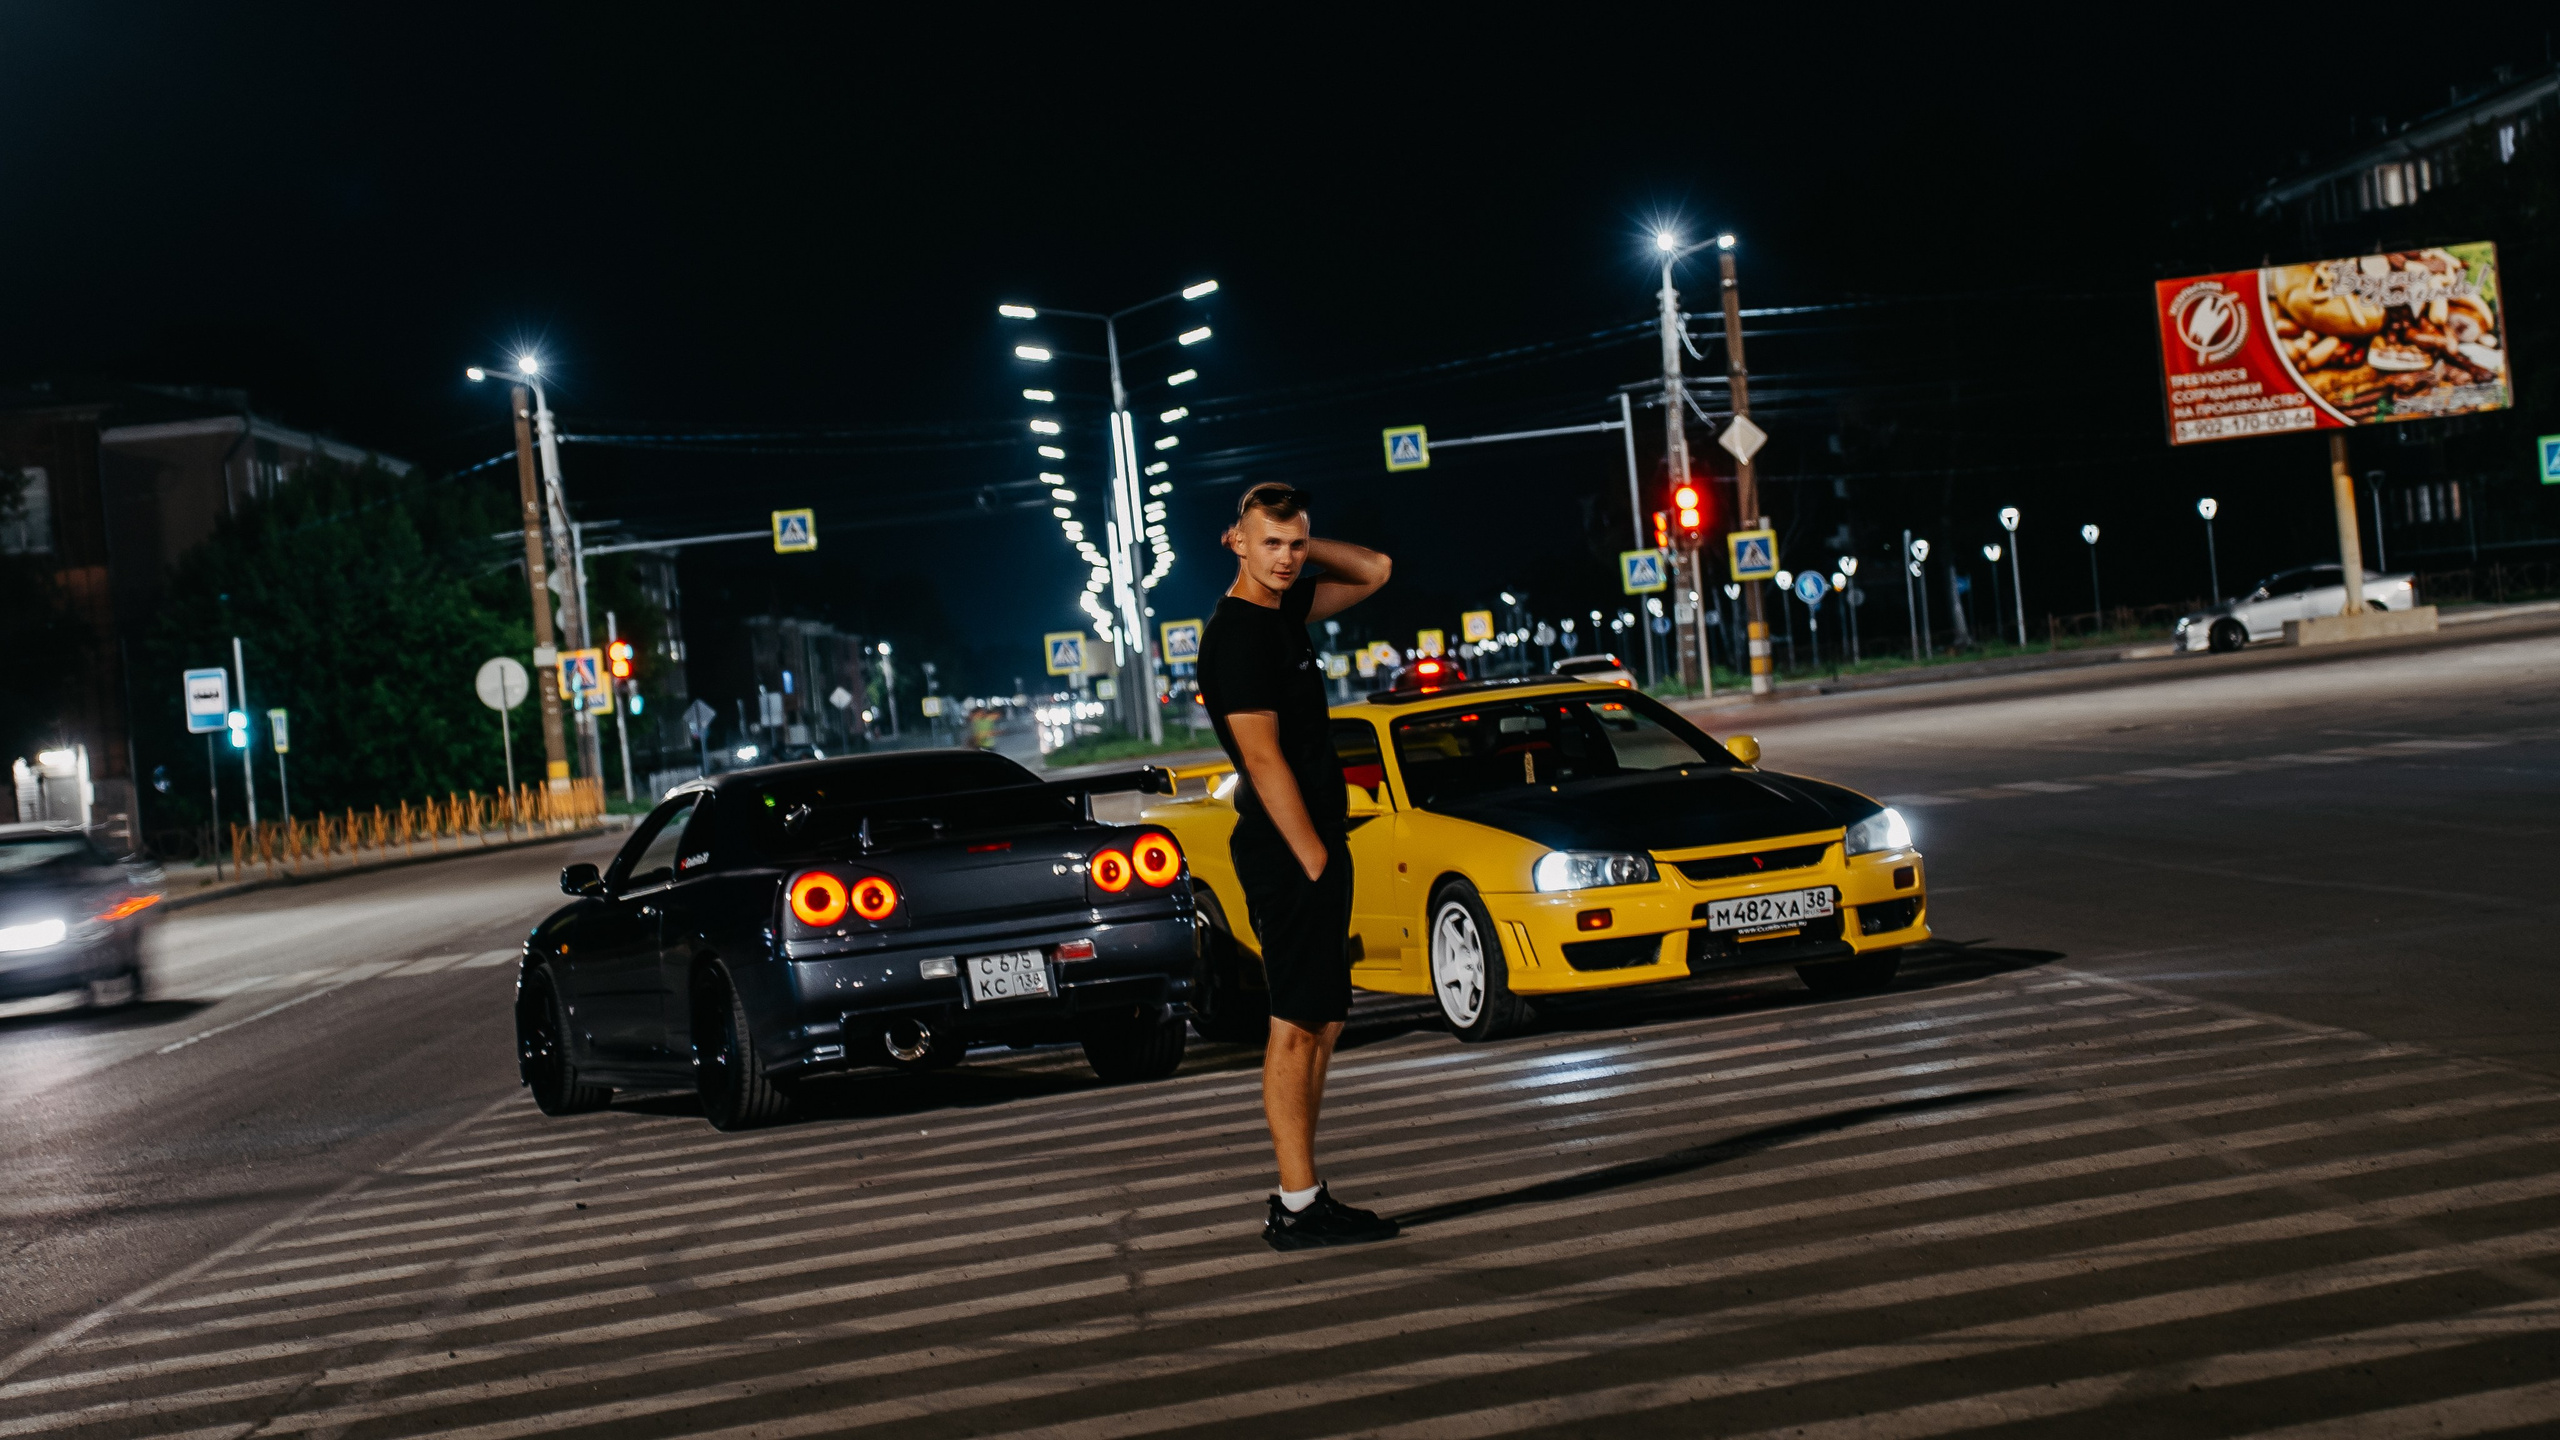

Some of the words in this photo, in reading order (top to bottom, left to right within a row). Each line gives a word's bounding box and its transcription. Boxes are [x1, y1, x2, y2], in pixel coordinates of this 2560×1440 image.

[1716, 899, 1800, 926] М482ХА
[1806, 891, 1826, 908] 38
[1000, 952, 1032, 972] 675
